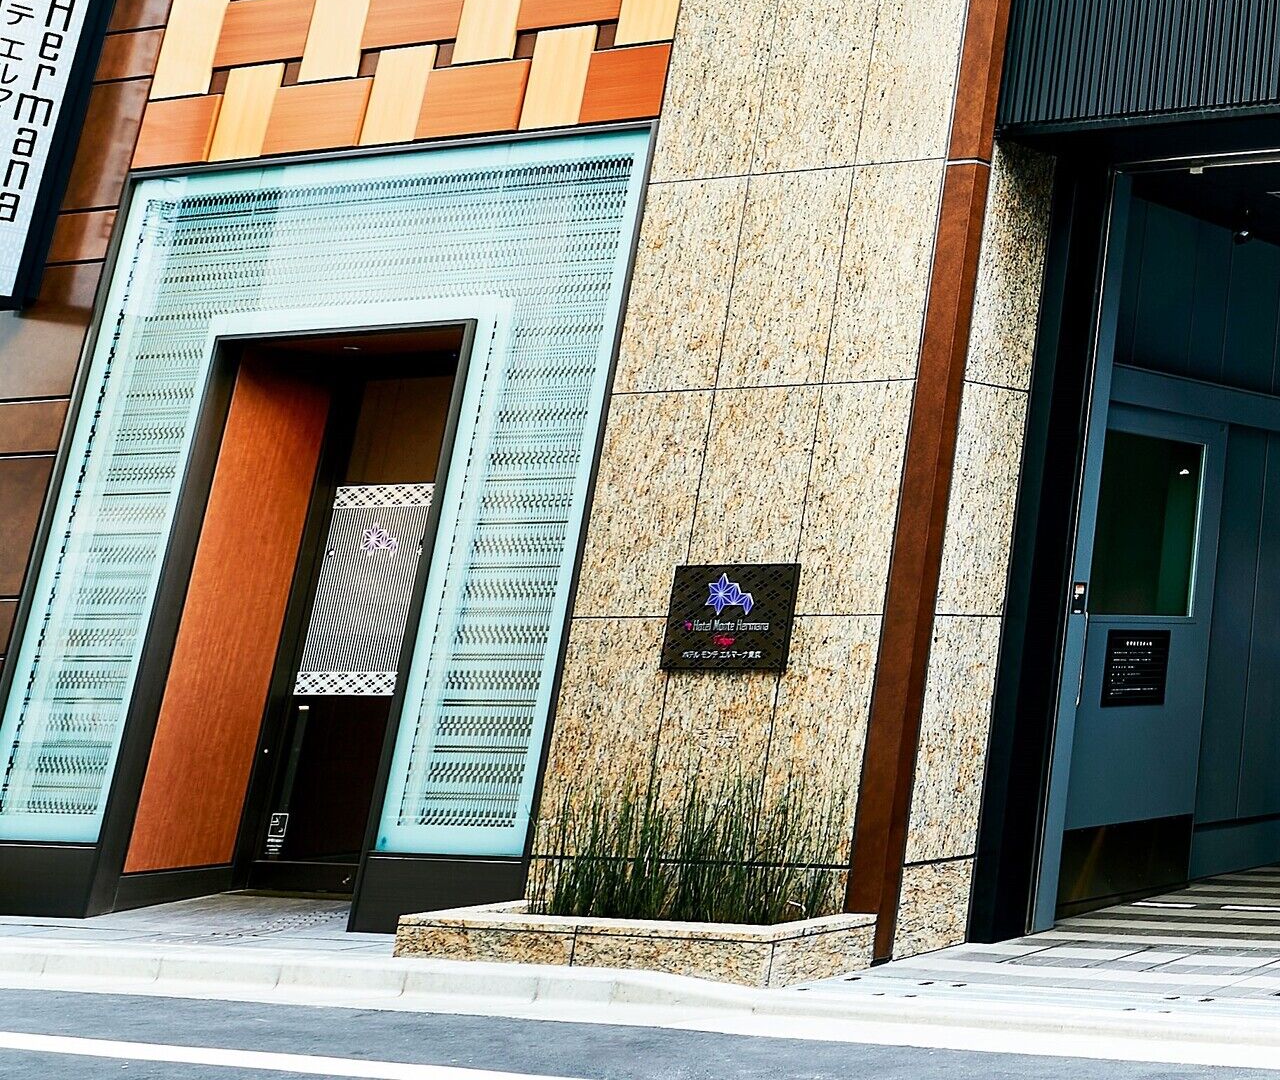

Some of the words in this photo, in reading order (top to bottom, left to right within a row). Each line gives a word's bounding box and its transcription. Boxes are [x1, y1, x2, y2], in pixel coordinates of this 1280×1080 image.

[692, 619, 712, 631] Hotel
[712, 619, 735, 631] Monte
[735, 619, 770, 631] Hermana
[681, 650, 700, 659] ホテル
[701, 650, 719, 659] モンテ
